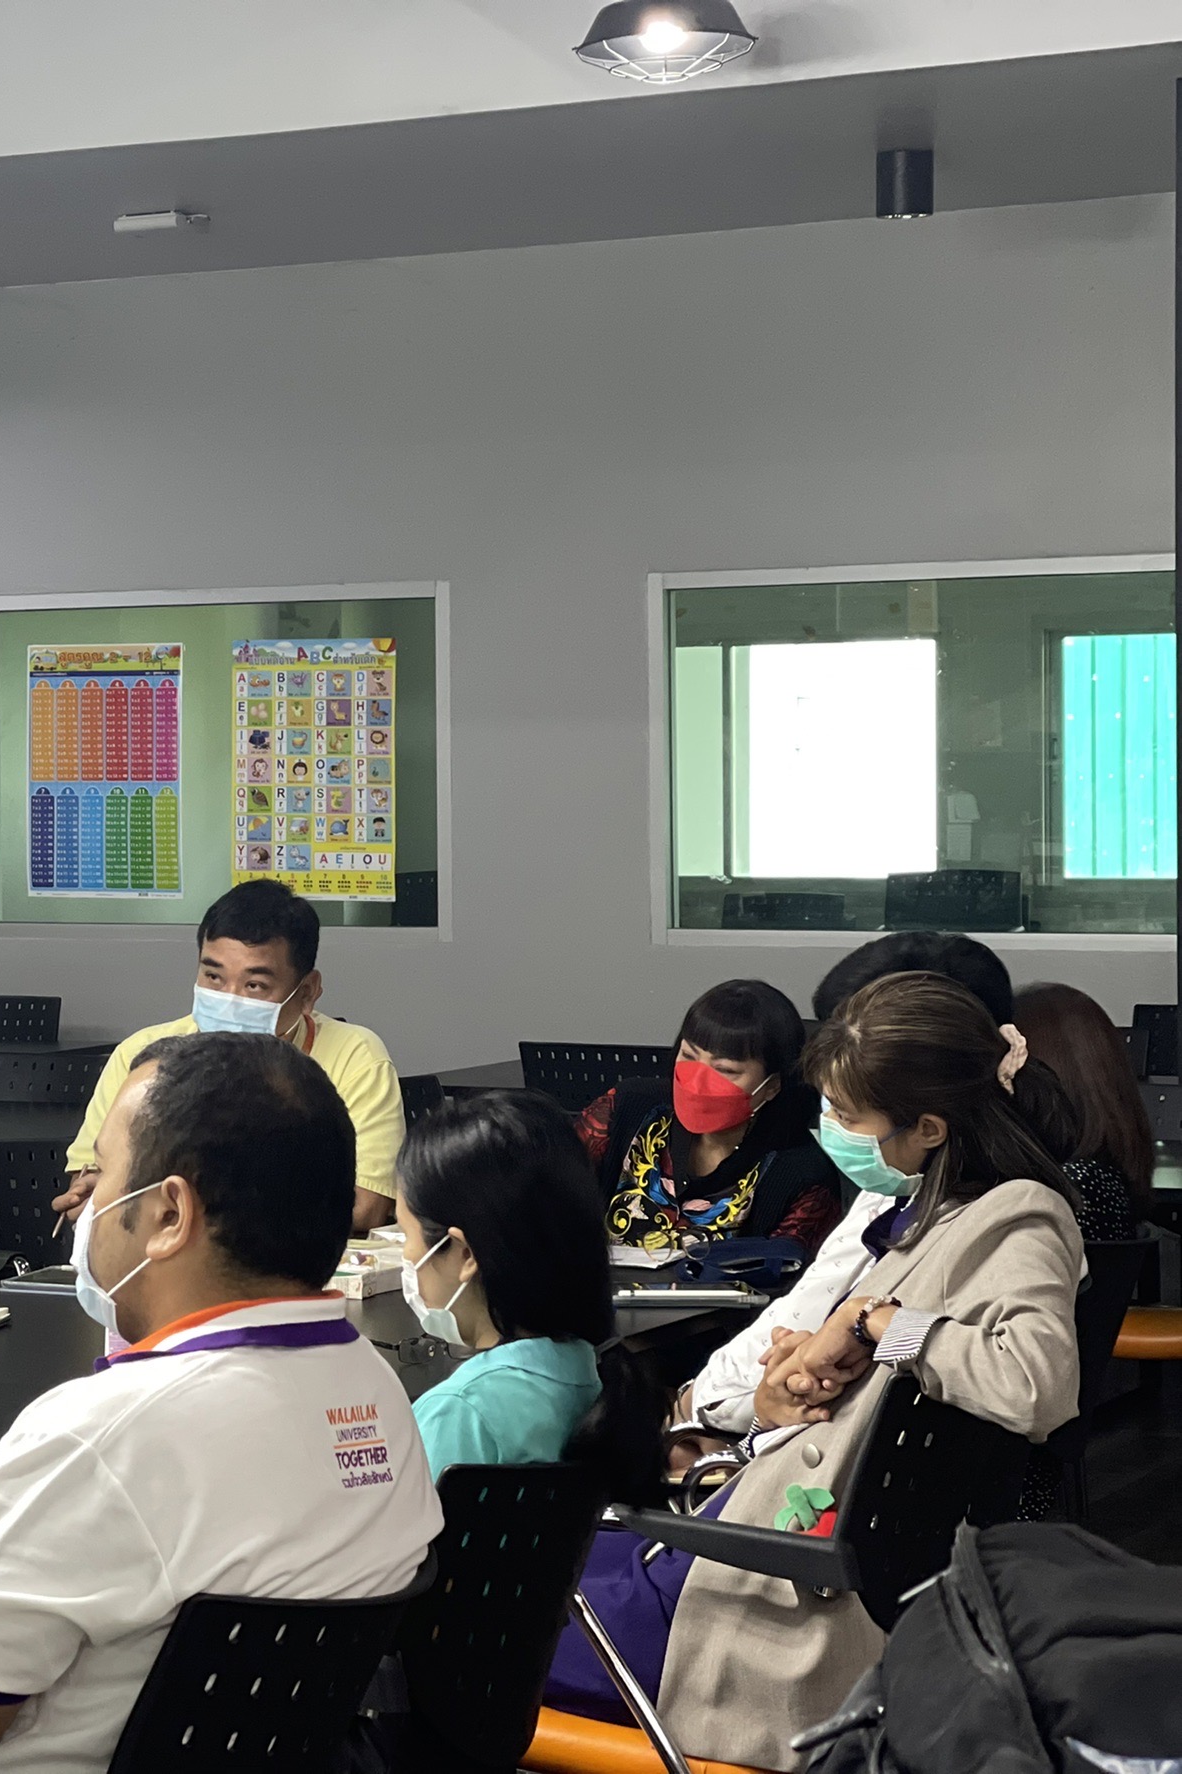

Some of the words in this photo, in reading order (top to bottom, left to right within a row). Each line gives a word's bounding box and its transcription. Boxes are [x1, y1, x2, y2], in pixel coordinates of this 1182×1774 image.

[58, 652, 104, 670] สูตรคูณ
[238, 673, 246, 682] A
[278, 672, 285, 682] B
[316, 672, 324, 682] C
[357, 672, 364, 682] D
[238, 702, 245, 712] E
[278, 701, 284, 711] F
[316, 701, 324, 711] G
[356, 701, 364, 711] H
[278, 730, 284, 741] J
[316, 730, 324, 740] K
[357, 730, 364, 740] L
[237, 759, 246, 768] M
[277, 760, 284, 769] N
[316, 759, 325, 770] O
[357, 759, 364, 769] P
[237, 788, 246, 798] Q
[277, 788, 285, 798] R
[317, 788, 324, 798] S
[357, 788, 364, 798] T
[237, 817, 244, 827] U
[277, 817, 284, 827] V
[316, 818, 326, 827] W
[357, 818, 364, 828] X
[238, 845, 244, 855] Y
[277, 846, 284, 856] Z
[320, 854, 328, 864] A
[336, 854, 343, 864] E
[363, 854, 372, 864] O
[379, 854, 386, 864] U
[326, 1404, 378, 1425] WALAILAK
[335, 1425, 378, 1442] UNIVERSITY
[334, 1446, 388, 1470] TOGETHER
